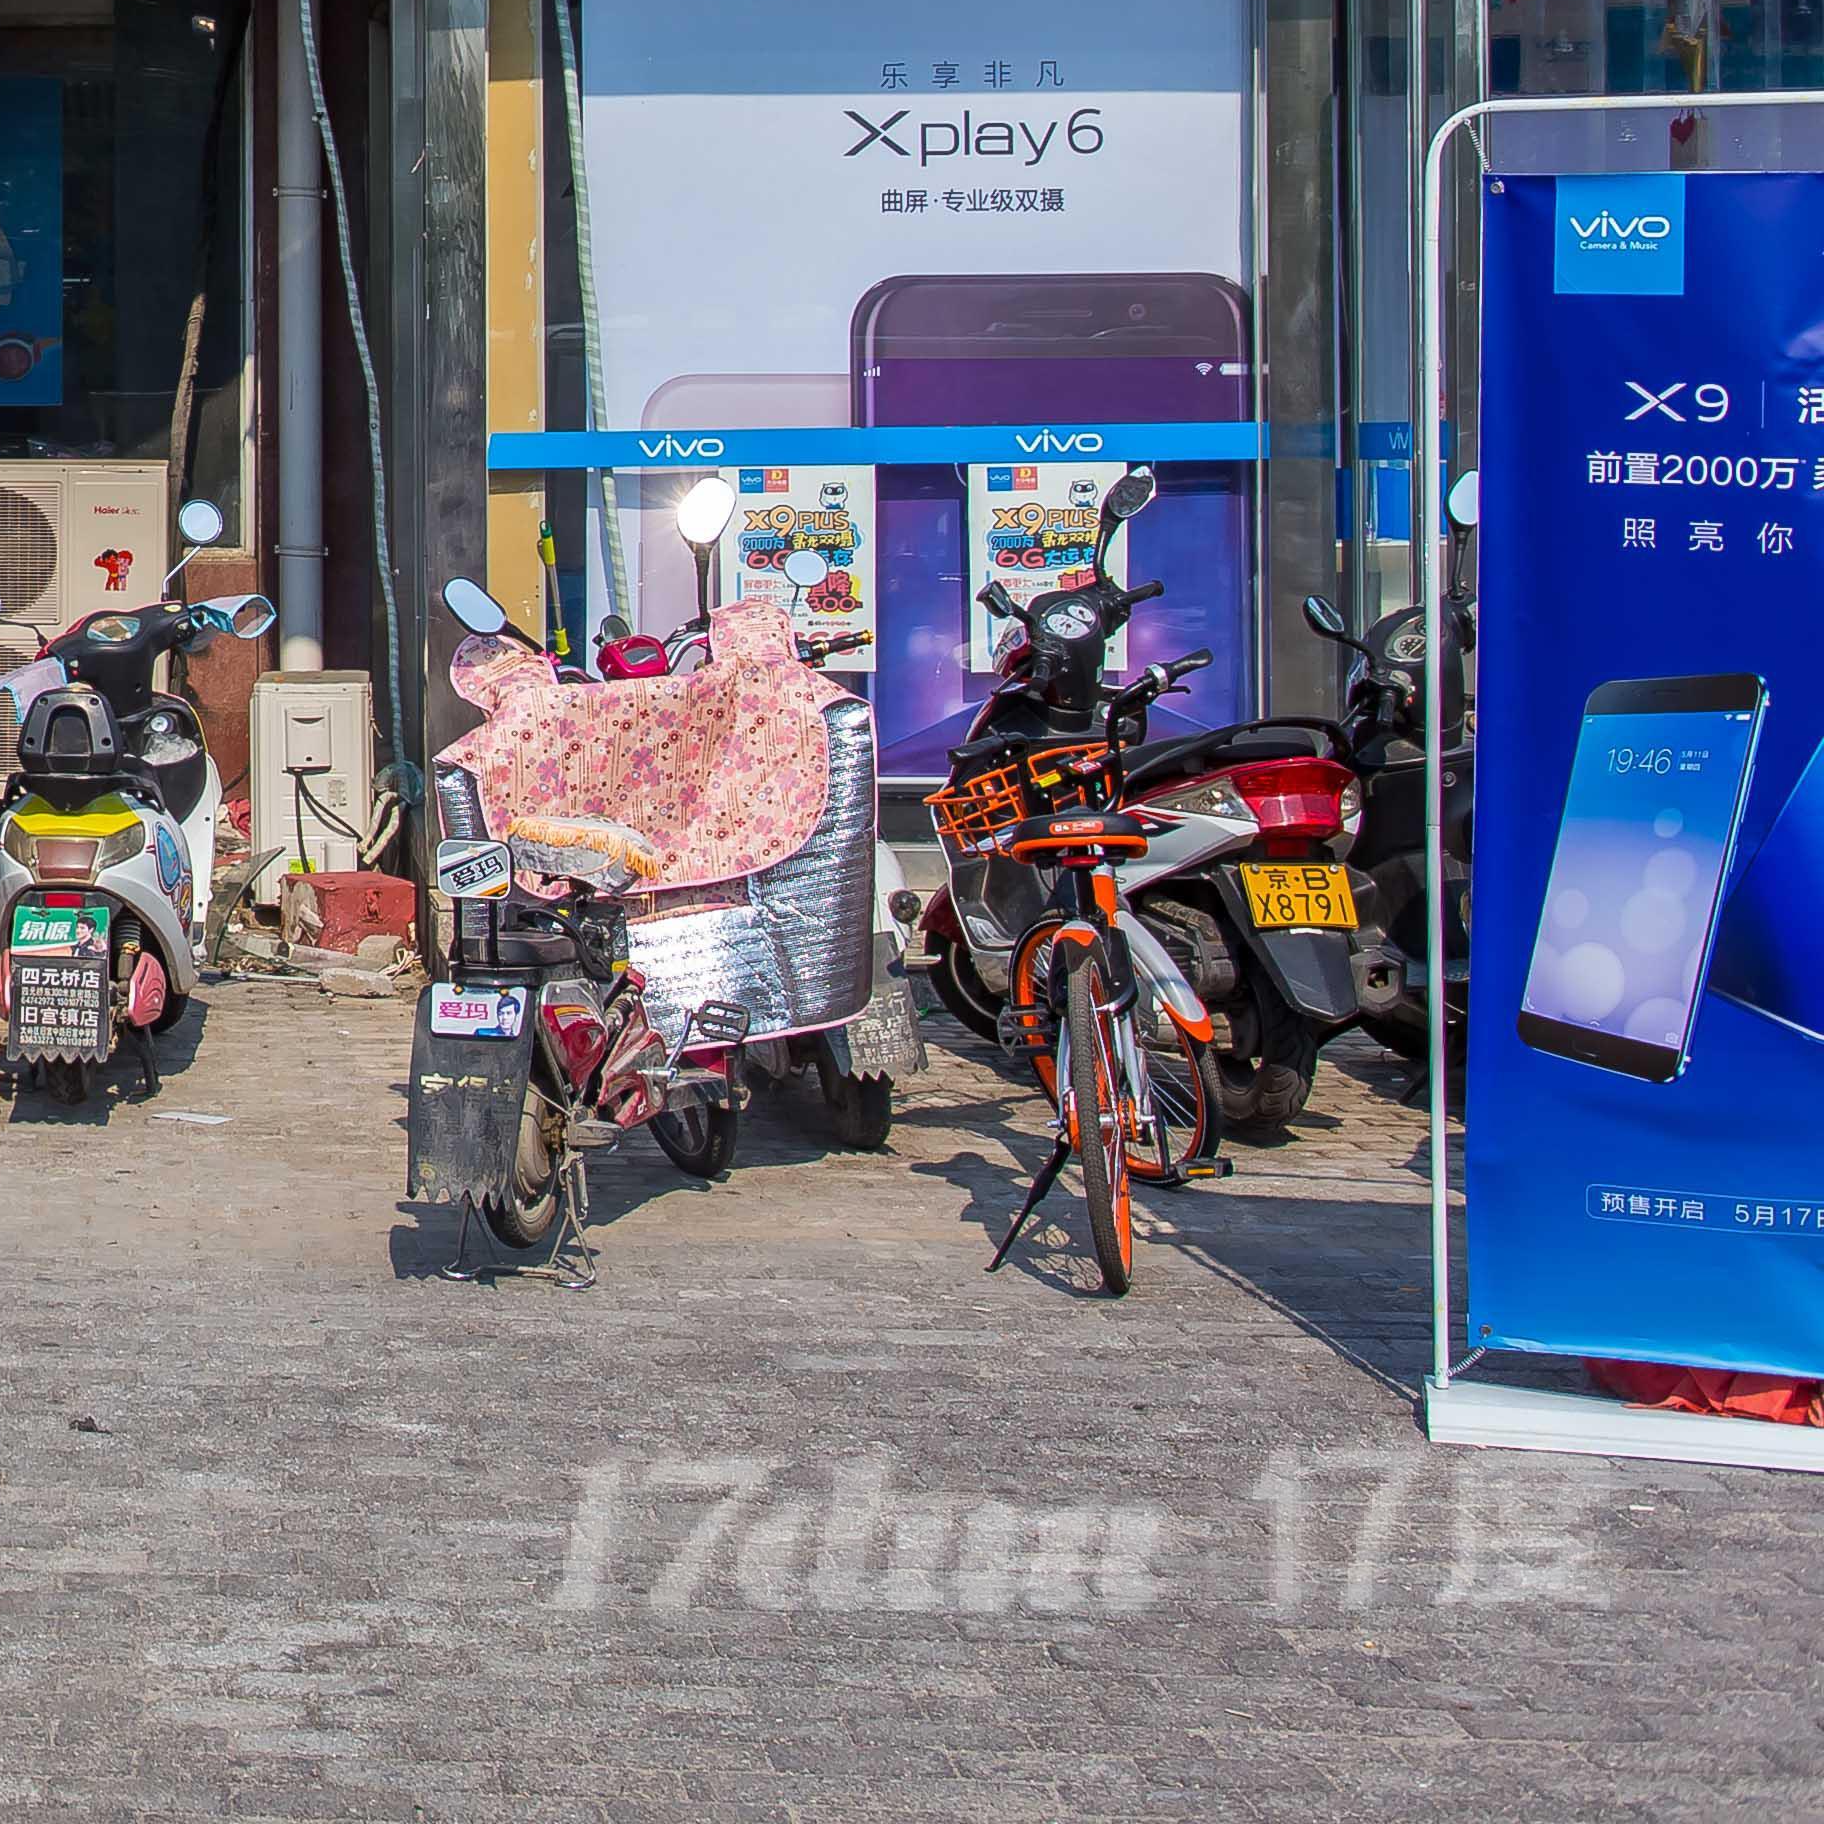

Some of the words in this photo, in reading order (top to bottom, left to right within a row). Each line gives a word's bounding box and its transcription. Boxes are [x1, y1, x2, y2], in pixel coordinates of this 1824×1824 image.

[879, 60, 1066, 90] 乐享非凡
[1569, 209, 1671, 239] vivo
[1579, 239, 1618, 251] Camera
[1630, 239, 1660, 251] Music
[1623, 381, 1731, 424] X9
[637, 434, 726, 459] vivo
[1015, 429, 1104, 453] vivo
[1586, 450, 1798, 490] 前置2000万
[1622, 516, 1794, 553] 照亮你
[1607, 747, 1673, 775] 19:46
[453, 856, 504, 891] 爱玛
[1254, 892, 1351, 927] X8791
[19, 920, 72, 941] 绿源
[21, 967, 100, 988] 四元桥店
[20, 1006, 99, 1027] 旧宫镇店
[438, 1000, 489, 1021] 爱玛
[1600, 1190, 1705, 1223] 预售开启
